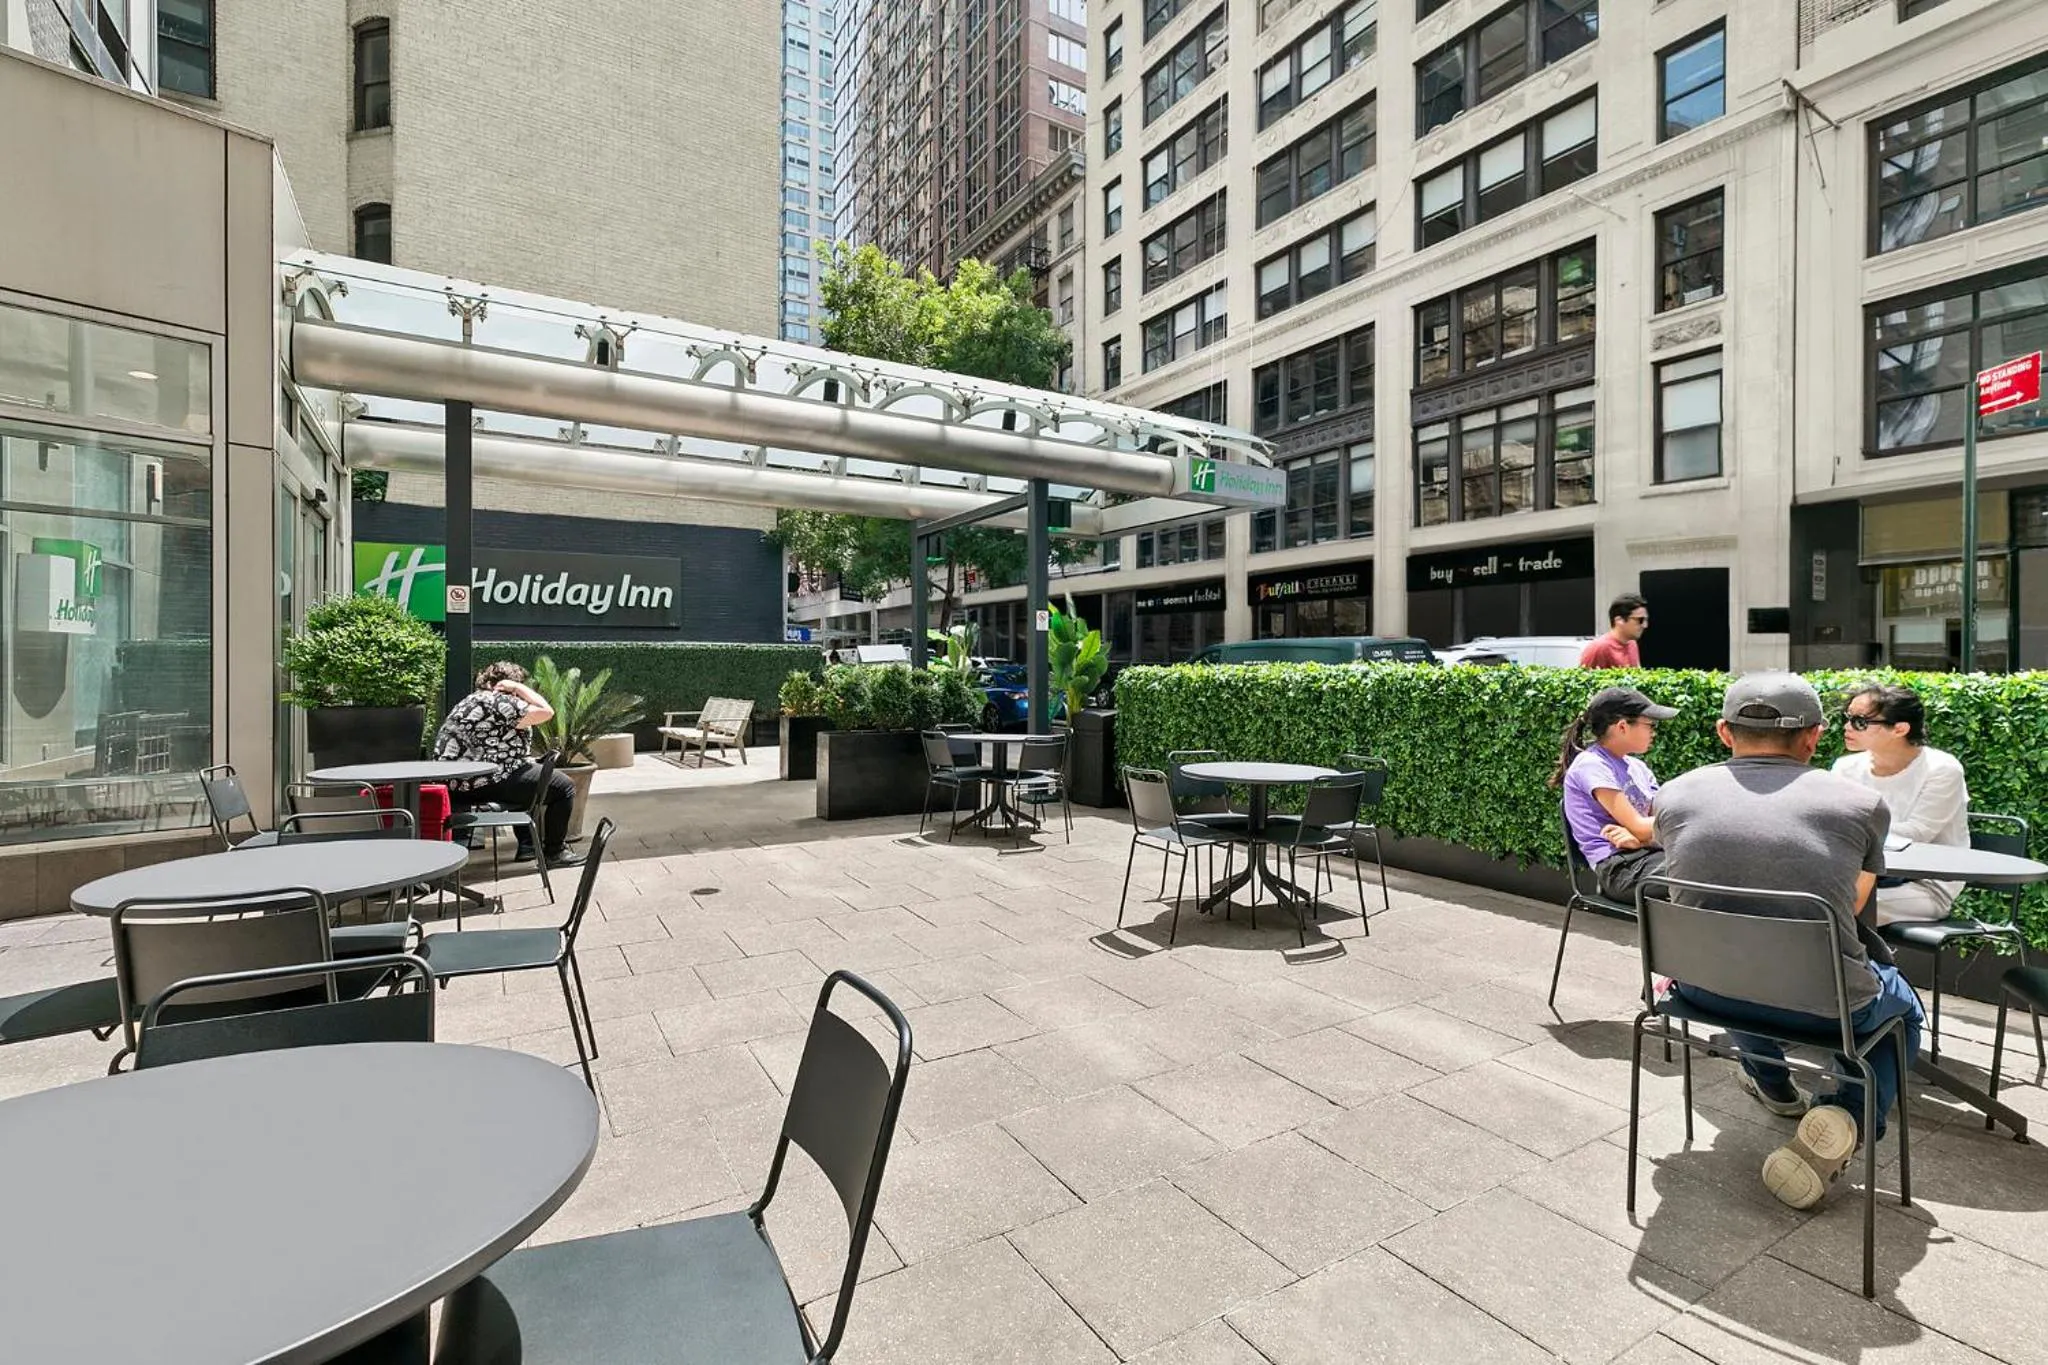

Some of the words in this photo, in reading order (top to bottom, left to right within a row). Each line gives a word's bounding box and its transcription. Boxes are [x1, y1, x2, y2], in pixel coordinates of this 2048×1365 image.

[1992, 359, 2033, 381] STANDING
[1220, 470, 1264, 496] Holiday
[1430, 566, 1454, 584] buy
[1472, 556, 1498, 576] sell
[1518, 550, 1563, 572] trade
[471, 567, 614, 615] Holiday
[618, 574, 673, 608] Inn
